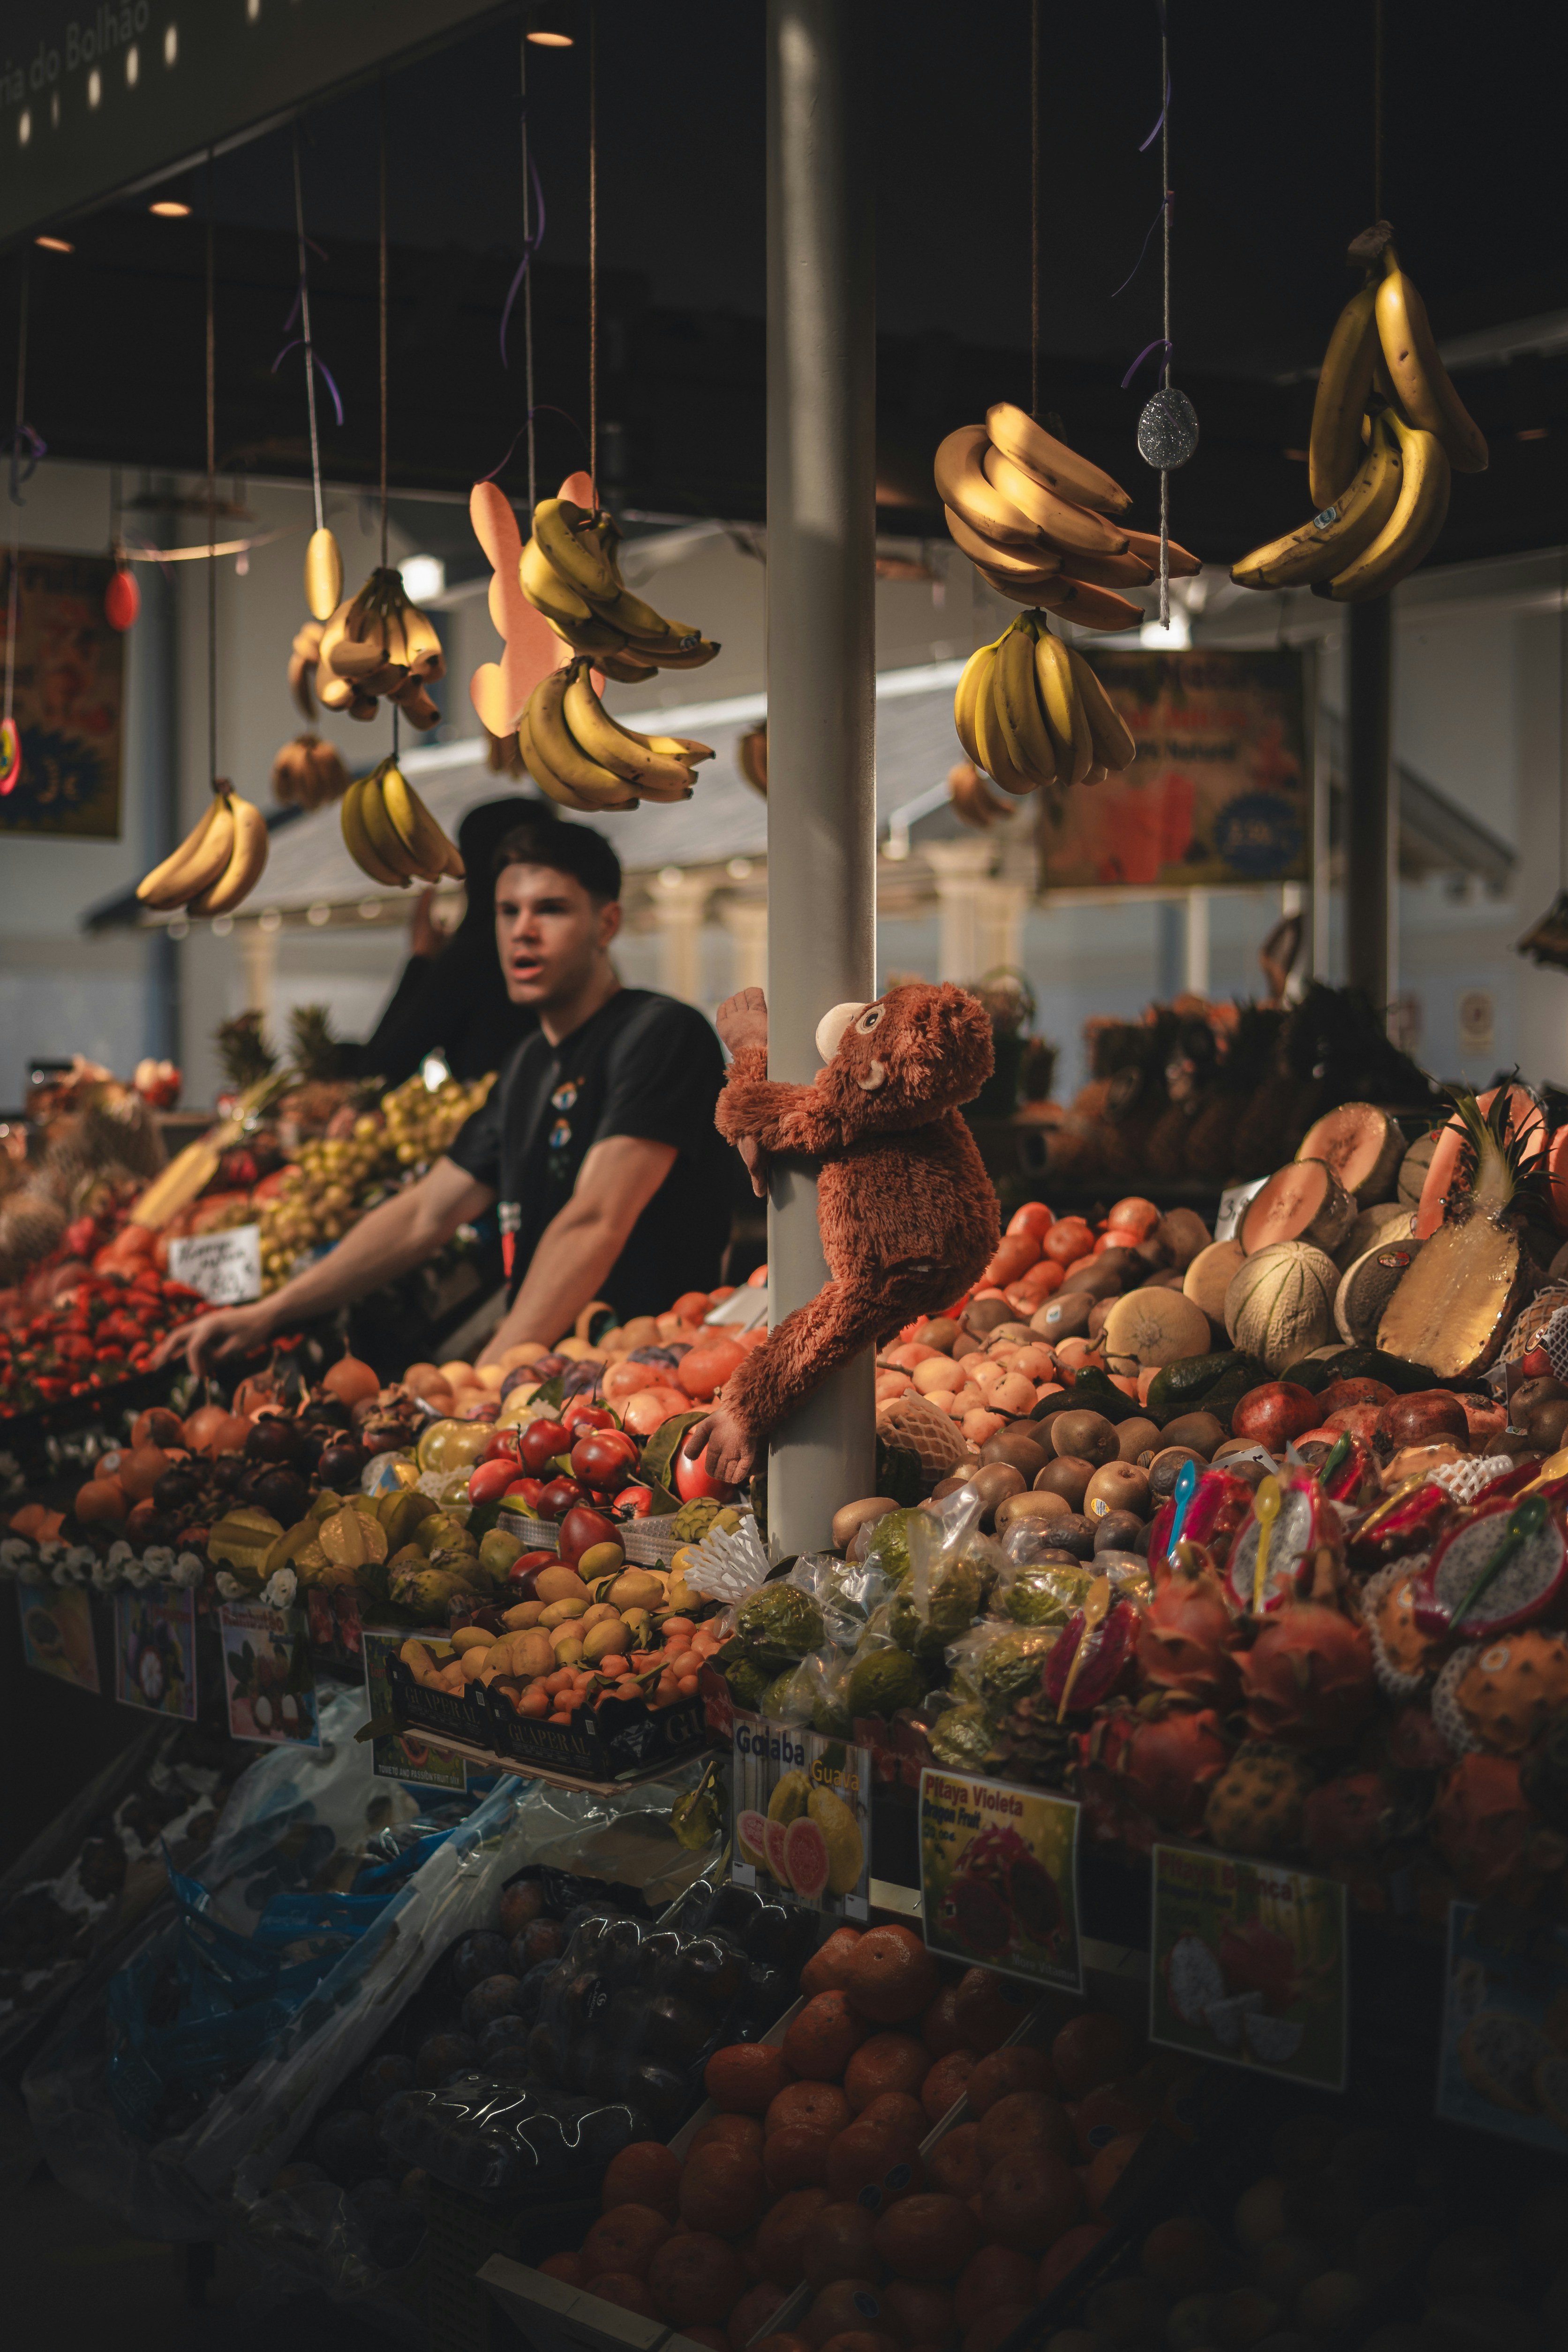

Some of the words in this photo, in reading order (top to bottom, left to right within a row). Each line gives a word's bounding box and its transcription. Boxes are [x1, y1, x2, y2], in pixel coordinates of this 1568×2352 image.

[29, 40, 60, 91] do
[405, 1686, 480, 1725] GUAPERAL
[508, 1723, 591, 1755] GUAPERAL
[736, 1725, 805, 1766] Goiaba
[400, 1767, 410, 1778] AND
[434, 1771, 449, 1784] FRUIT
[450, 1776, 460, 1785] MIX
[811, 1759, 859, 1792] Guava
[922, 1798, 956, 1825] Dragon
[957, 1807, 981, 1829] Fruit
[926, 1774, 968, 1806] Pitaya
[973, 1785, 1023, 1816] Violeta
[1158, 1851, 1215, 1887] Pitaya
[1222, 1866, 1292, 1901] Branca
[1012, 1953, 1035, 1971] More
[1039, 1961, 1077, 1982] Vitamin
[588, 1981, 601, 2018] GLAMOUR
